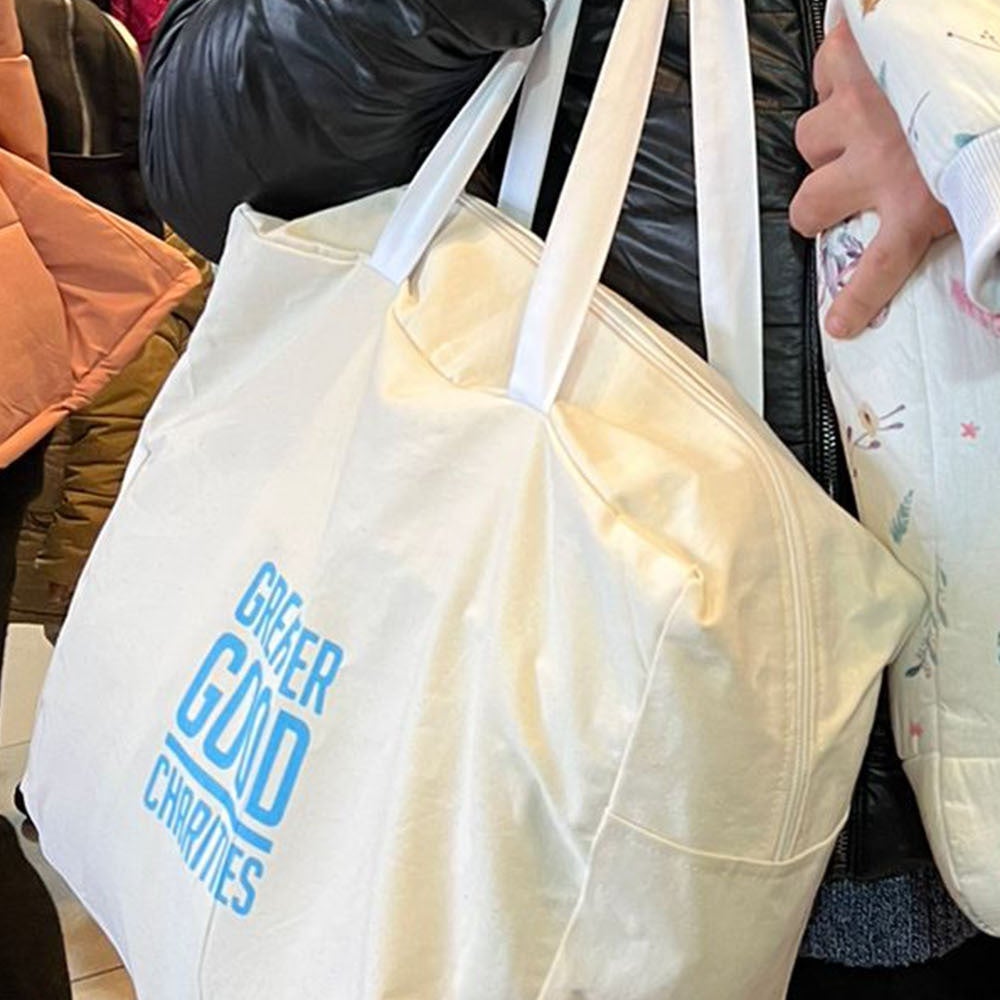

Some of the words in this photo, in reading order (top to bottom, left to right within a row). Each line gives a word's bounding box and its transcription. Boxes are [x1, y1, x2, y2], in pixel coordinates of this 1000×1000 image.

[234, 560, 344, 715] GREAER
[174, 632, 311, 829] GOOD
[143, 753, 265, 917] CHARITIES
